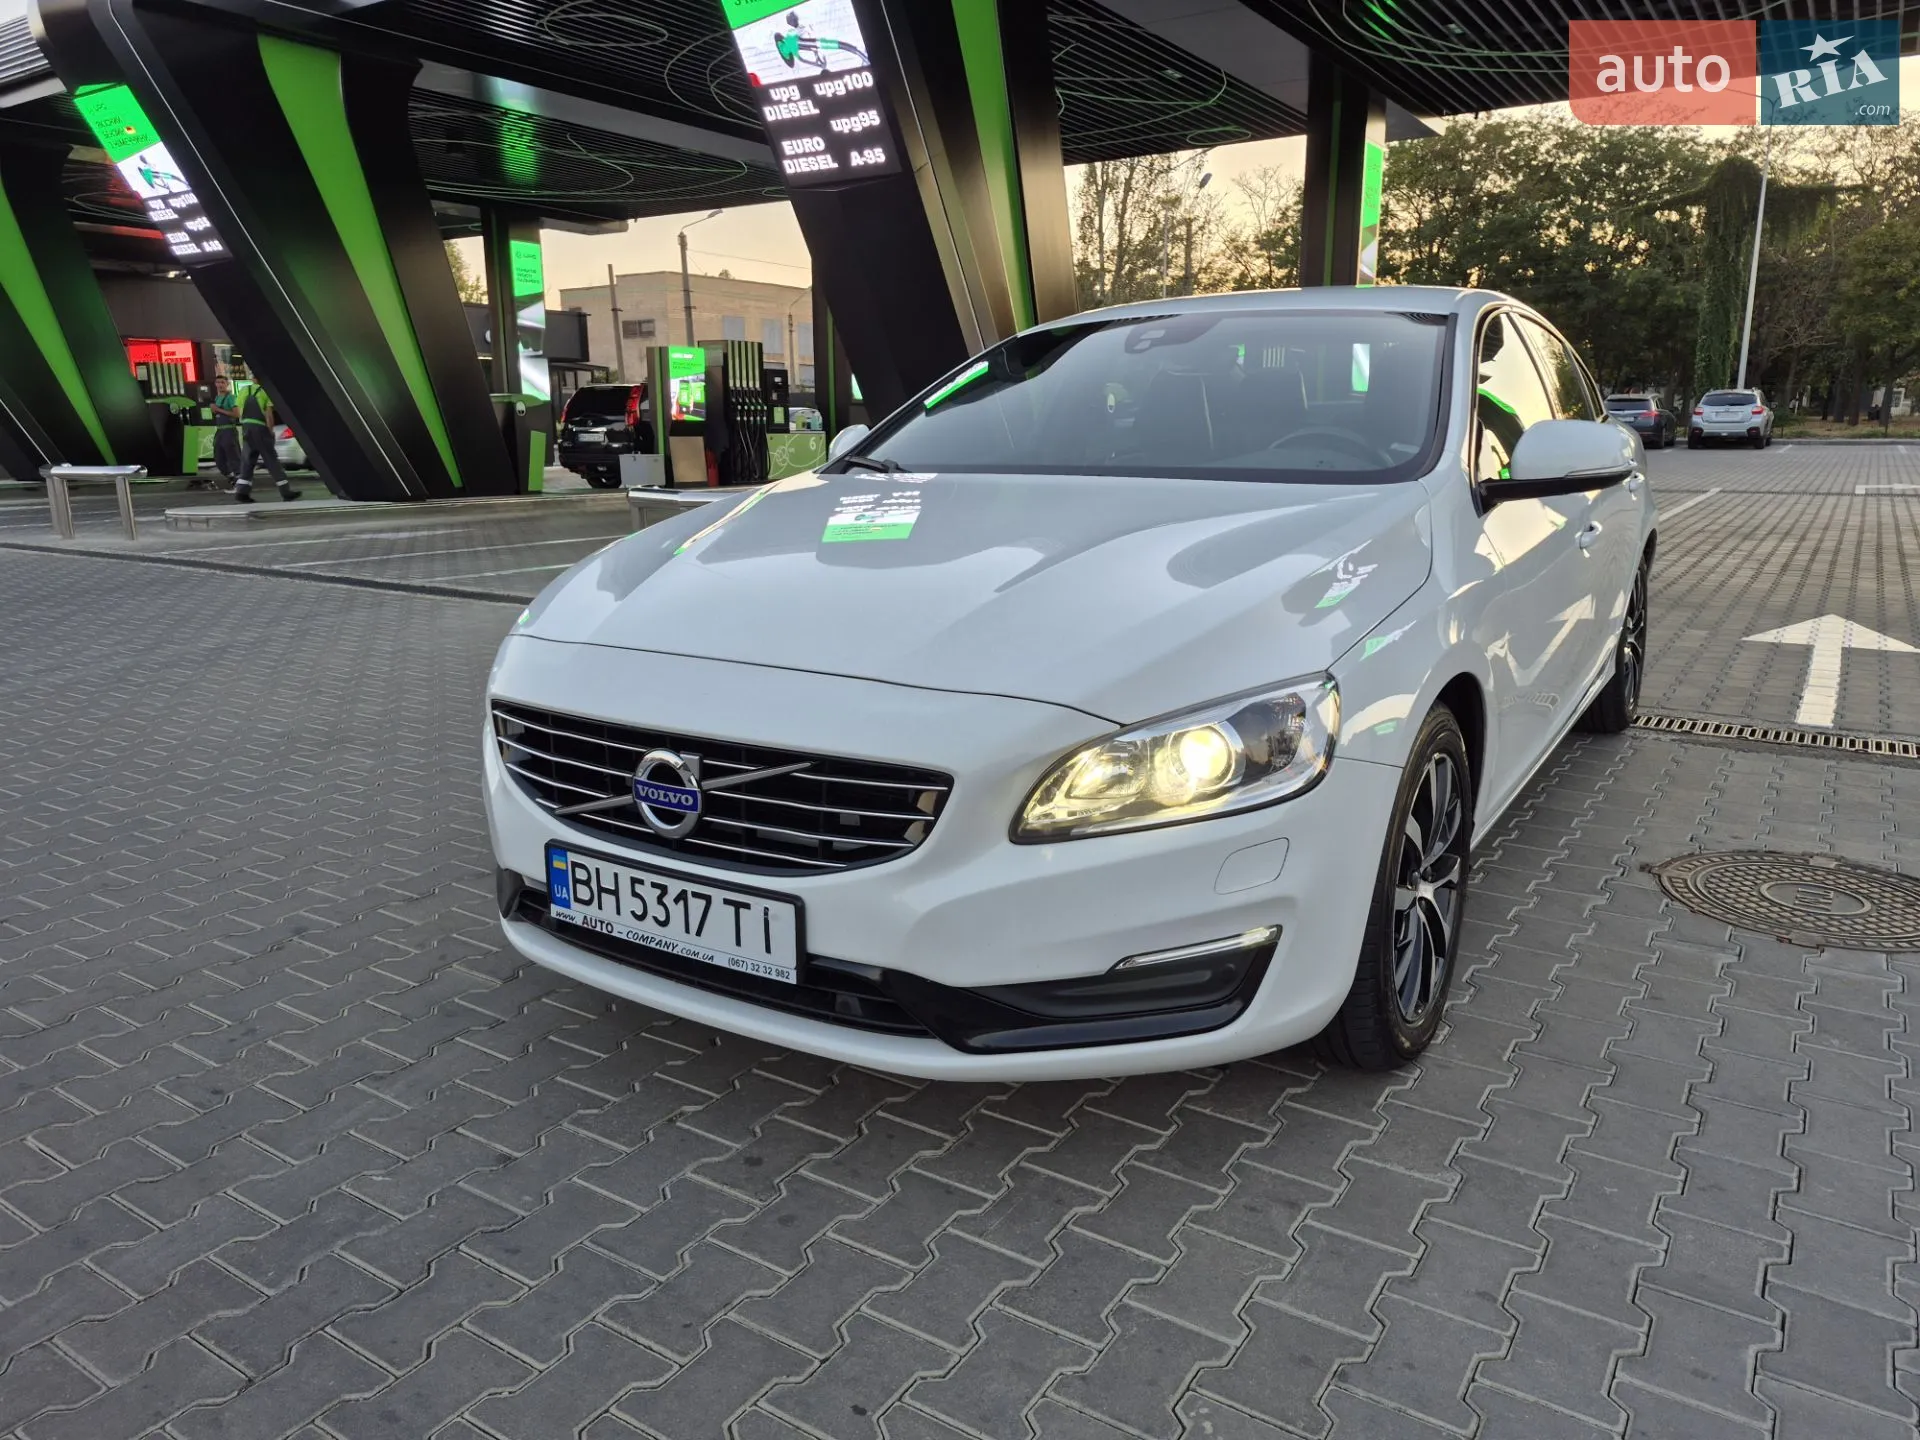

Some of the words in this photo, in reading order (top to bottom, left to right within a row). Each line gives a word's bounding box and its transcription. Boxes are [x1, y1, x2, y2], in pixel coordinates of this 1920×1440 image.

[769, 85, 800, 102] upg
[814, 71, 874, 97] upg100
[762, 99, 820, 122] DIESEL
[829, 110, 881, 133] upg95
[781, 136, 825, 156] EURO
[782, 154, 839, 174] DIESEL
[849, 148, 886, 167] A-95
[809, 438, 817, 450] 6
[636, 784, 694, 806] VOLVO
[553, 885, 569, 901] UA
[629, 875, 713, 938] 5317
[581, 914, 614, 934] AUTO
[728, 956, 748, 972] (067)
[775, 969, 791, 981] 982
